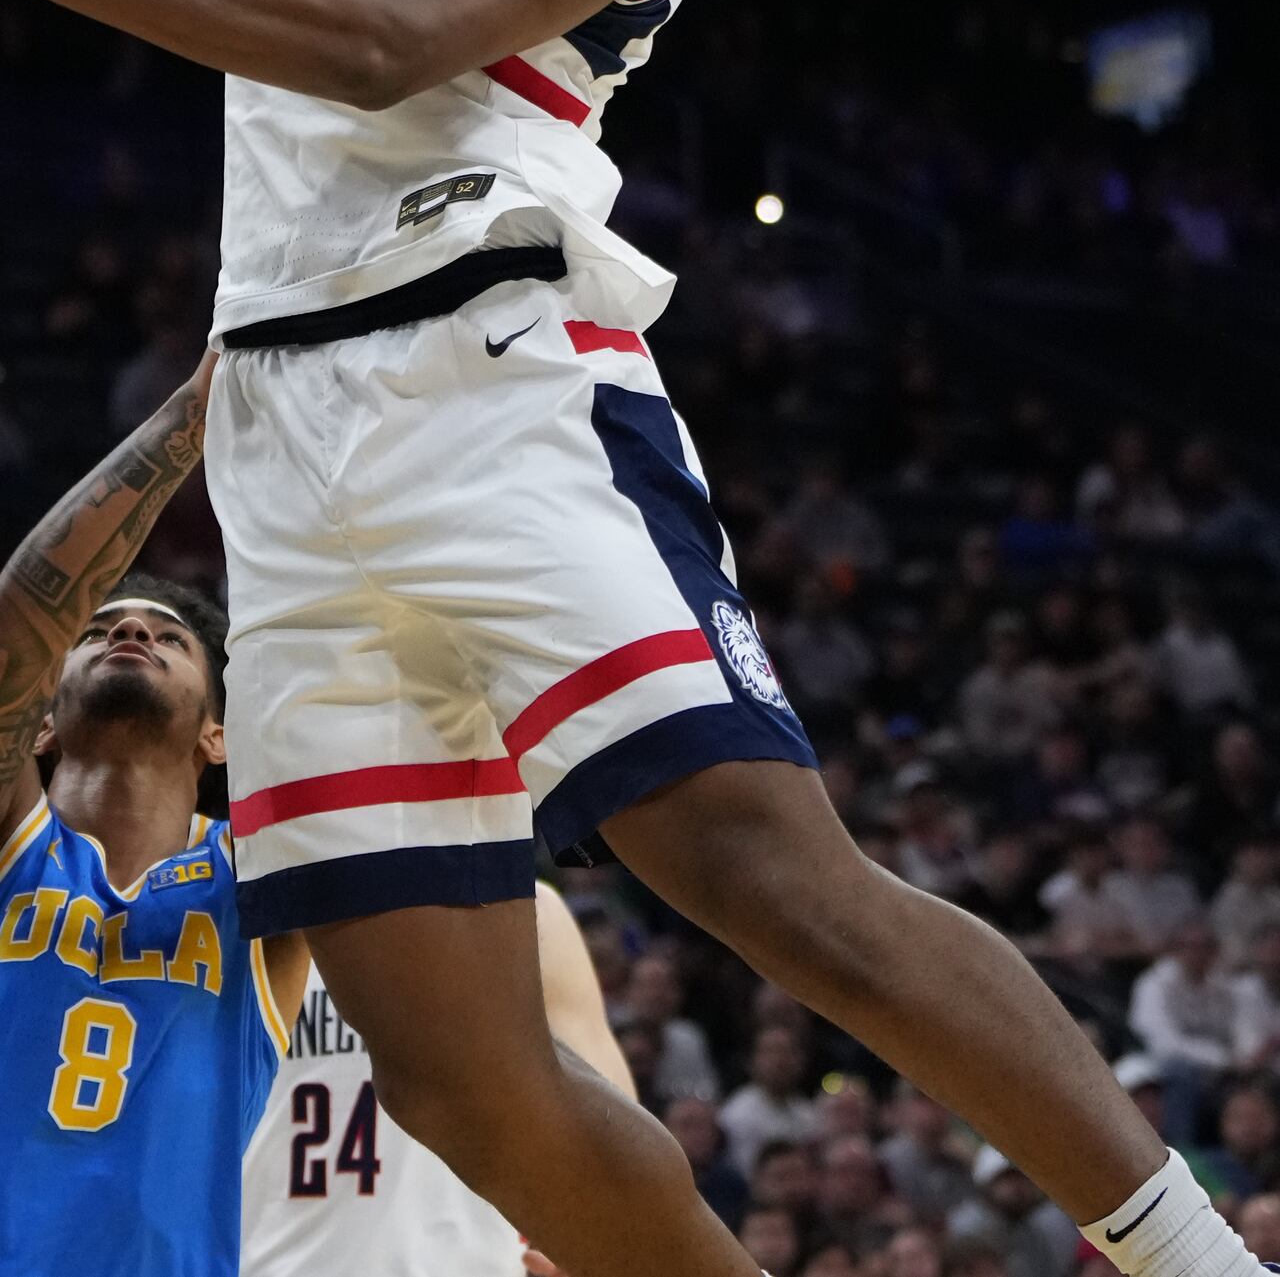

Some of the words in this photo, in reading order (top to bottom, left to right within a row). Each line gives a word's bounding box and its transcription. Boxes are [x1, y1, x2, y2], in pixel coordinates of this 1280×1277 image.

[455, 181, 474, 194] 52
[47, 996, 138, 1132] 8
[288, 1080, 382, 1199] 24
